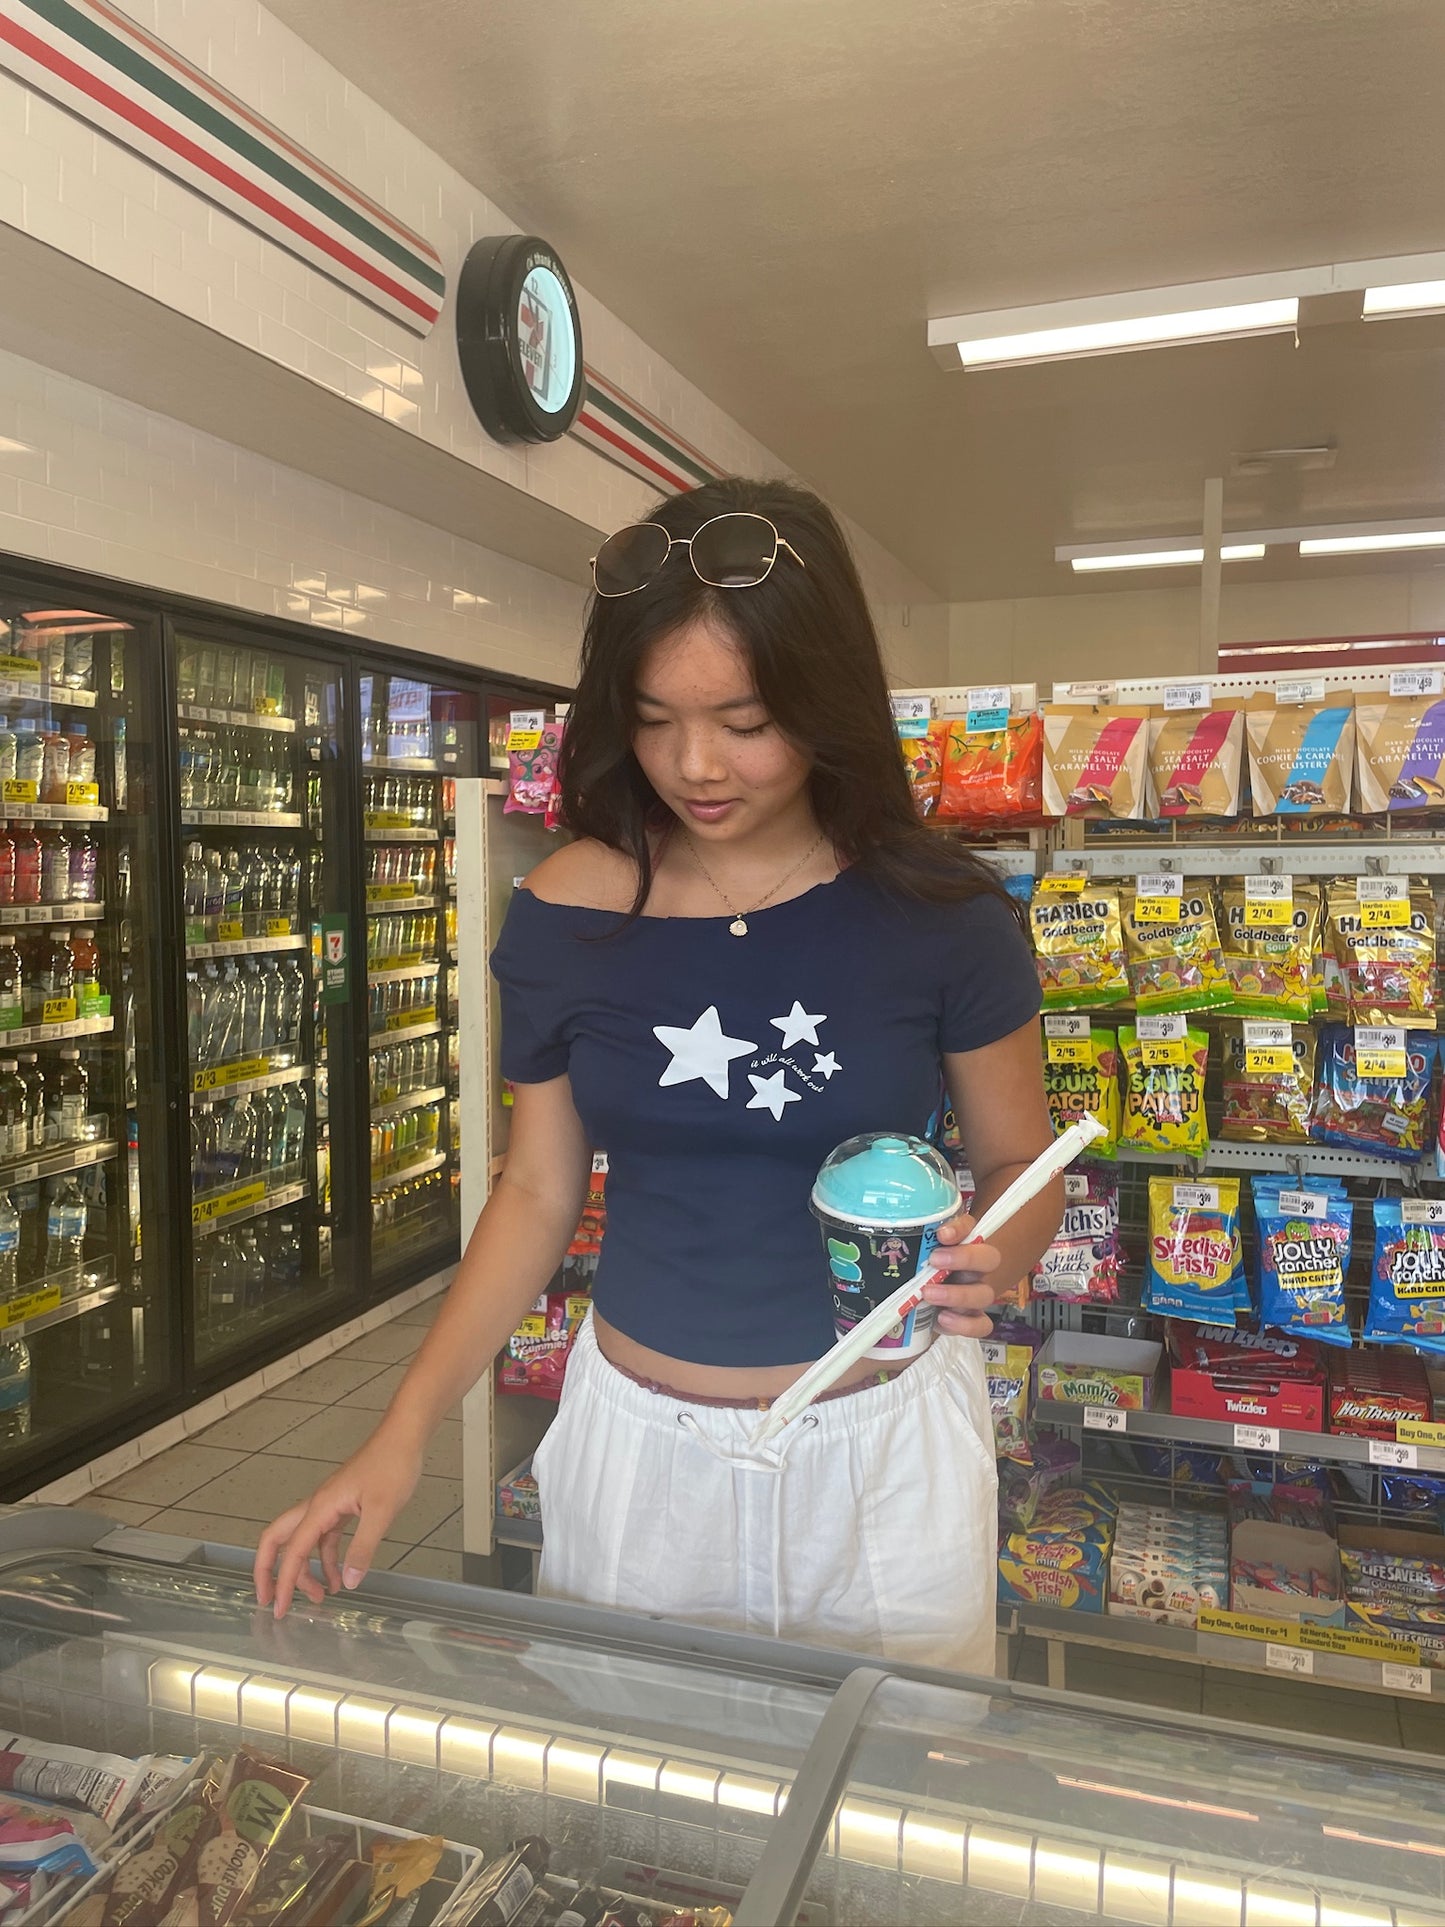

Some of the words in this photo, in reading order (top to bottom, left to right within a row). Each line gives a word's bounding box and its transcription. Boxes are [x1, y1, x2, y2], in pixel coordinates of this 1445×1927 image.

[1086, 749, 1121, 757] CHOCOLATE
[1179, 748, 1214, 756] CHOCOLATE
[1390, 746, 1411, 754] SEA
[1415, 744, 1440, 753] SALT
[1072, 754, 1090, 763] SEA
[1094, 754, 1117, 764] SALT
[1164, 755, 1182, 763] SEA
[1186, 753, 1210, 762] SALT
[1256, 753, 1292, 765] COOKIE
[1295, 753, 1302, 761] &
[1370, 752, 1423, 765] CARAMEL
[1053, 763, 1101, 772] CARAMEL
[1196, 761, 1227, 770] THINS
[1280, 760, 1329, 770] CLUSTERS
[1035, 901, 1109, 924] HARIBO
[1141, 905, 1162, 916] 2/$4
[1252, 908, 1273, 919] 2/$4
[1368, 910, 1391, 921] 2/$4
[1042, 924, 1105, 938] Goldbears
[1137, 922, 1202, 942] Goldbears
[1234, 929, 1299, 943] Goldbears
[1265, 943, 1290, 952] Sour
[1056, 1048, 1075, 1058] 2/$5
[1149, 1049, 1169, 1059] 2/$5
[1253, 1055, 1274, 1066] 2/$4
[1364, 1060, 1386, 1070] 2/$4
[750, 1060, 760, 1068] it
[761, 1053, 778, 1066] will
[778, 1057, 796, 1066] all
[791, 1064, 812, 1082] work
[806, 1081, 825, 1093] out
[1131, 1073, 1195, 1093] SOUR
[1047, 1092, 1100, 1111] ATCH
[1129, 1092, 1199, 1116] PATCH
[1153, 1236, 1233, 1263] Swedish
[1274, 1238, 1334, 1263] JOLLY
[1054, 1250, 1086, 1263] Fruit
[1045, 1260, 1091, 1275] Snacks
[1172, 1255, 1218, 1279] Fish
[1278, 1256, 1338, 1274] rancher
[1281, 1274, 1308, 1286] HARD
[1309, 1273, 1339, 1284] CANDY
[1397, 1286, 1424, 1295] HARD
[521, 1340, 568, 1356] Gummies
[1062, 1379, 1120, 1404] Mamba
[1225, 1399, 1268, 1416] Twizzlers
[1338, 1401, 1366, 1418] HOT
[1399, 1428, 1416, 1440] Buy
[1416, 1430, 1436, 1441] One,
[1025, 1543, 1078, 1556] Swedish
[1035, 1549, 1065, 1560] Fish
[1036, 1557, 1060, 1568] mini
[1021, 1567, 1074, 1590] Swedish
[1034, 1582, 1063, 1597] Fish
[1200, 1615, 1216, 1628] Buy
[1216, 1618, 1235, 1631] One,
[1234, 1621, 1249, 1632] Get
[1249, 1624, 1265, 1635] One
[1264, 1626, 1279, 1636] For
[1279, 1628, 1288, 1638] $1
[1299, 1636, 1332, 1649] Standard
[1332, 1641, 1346, 1651] Size
[1309, 1629, 1332, 1640] Nerds,
[1380, 1640, 1398, 1651] Laffy
[1398, 1643, 1416, 1654] Taffy
[221, 1842, 250, 1888] COOKIE
[137, 1857, 178, 1898] COOKIE
